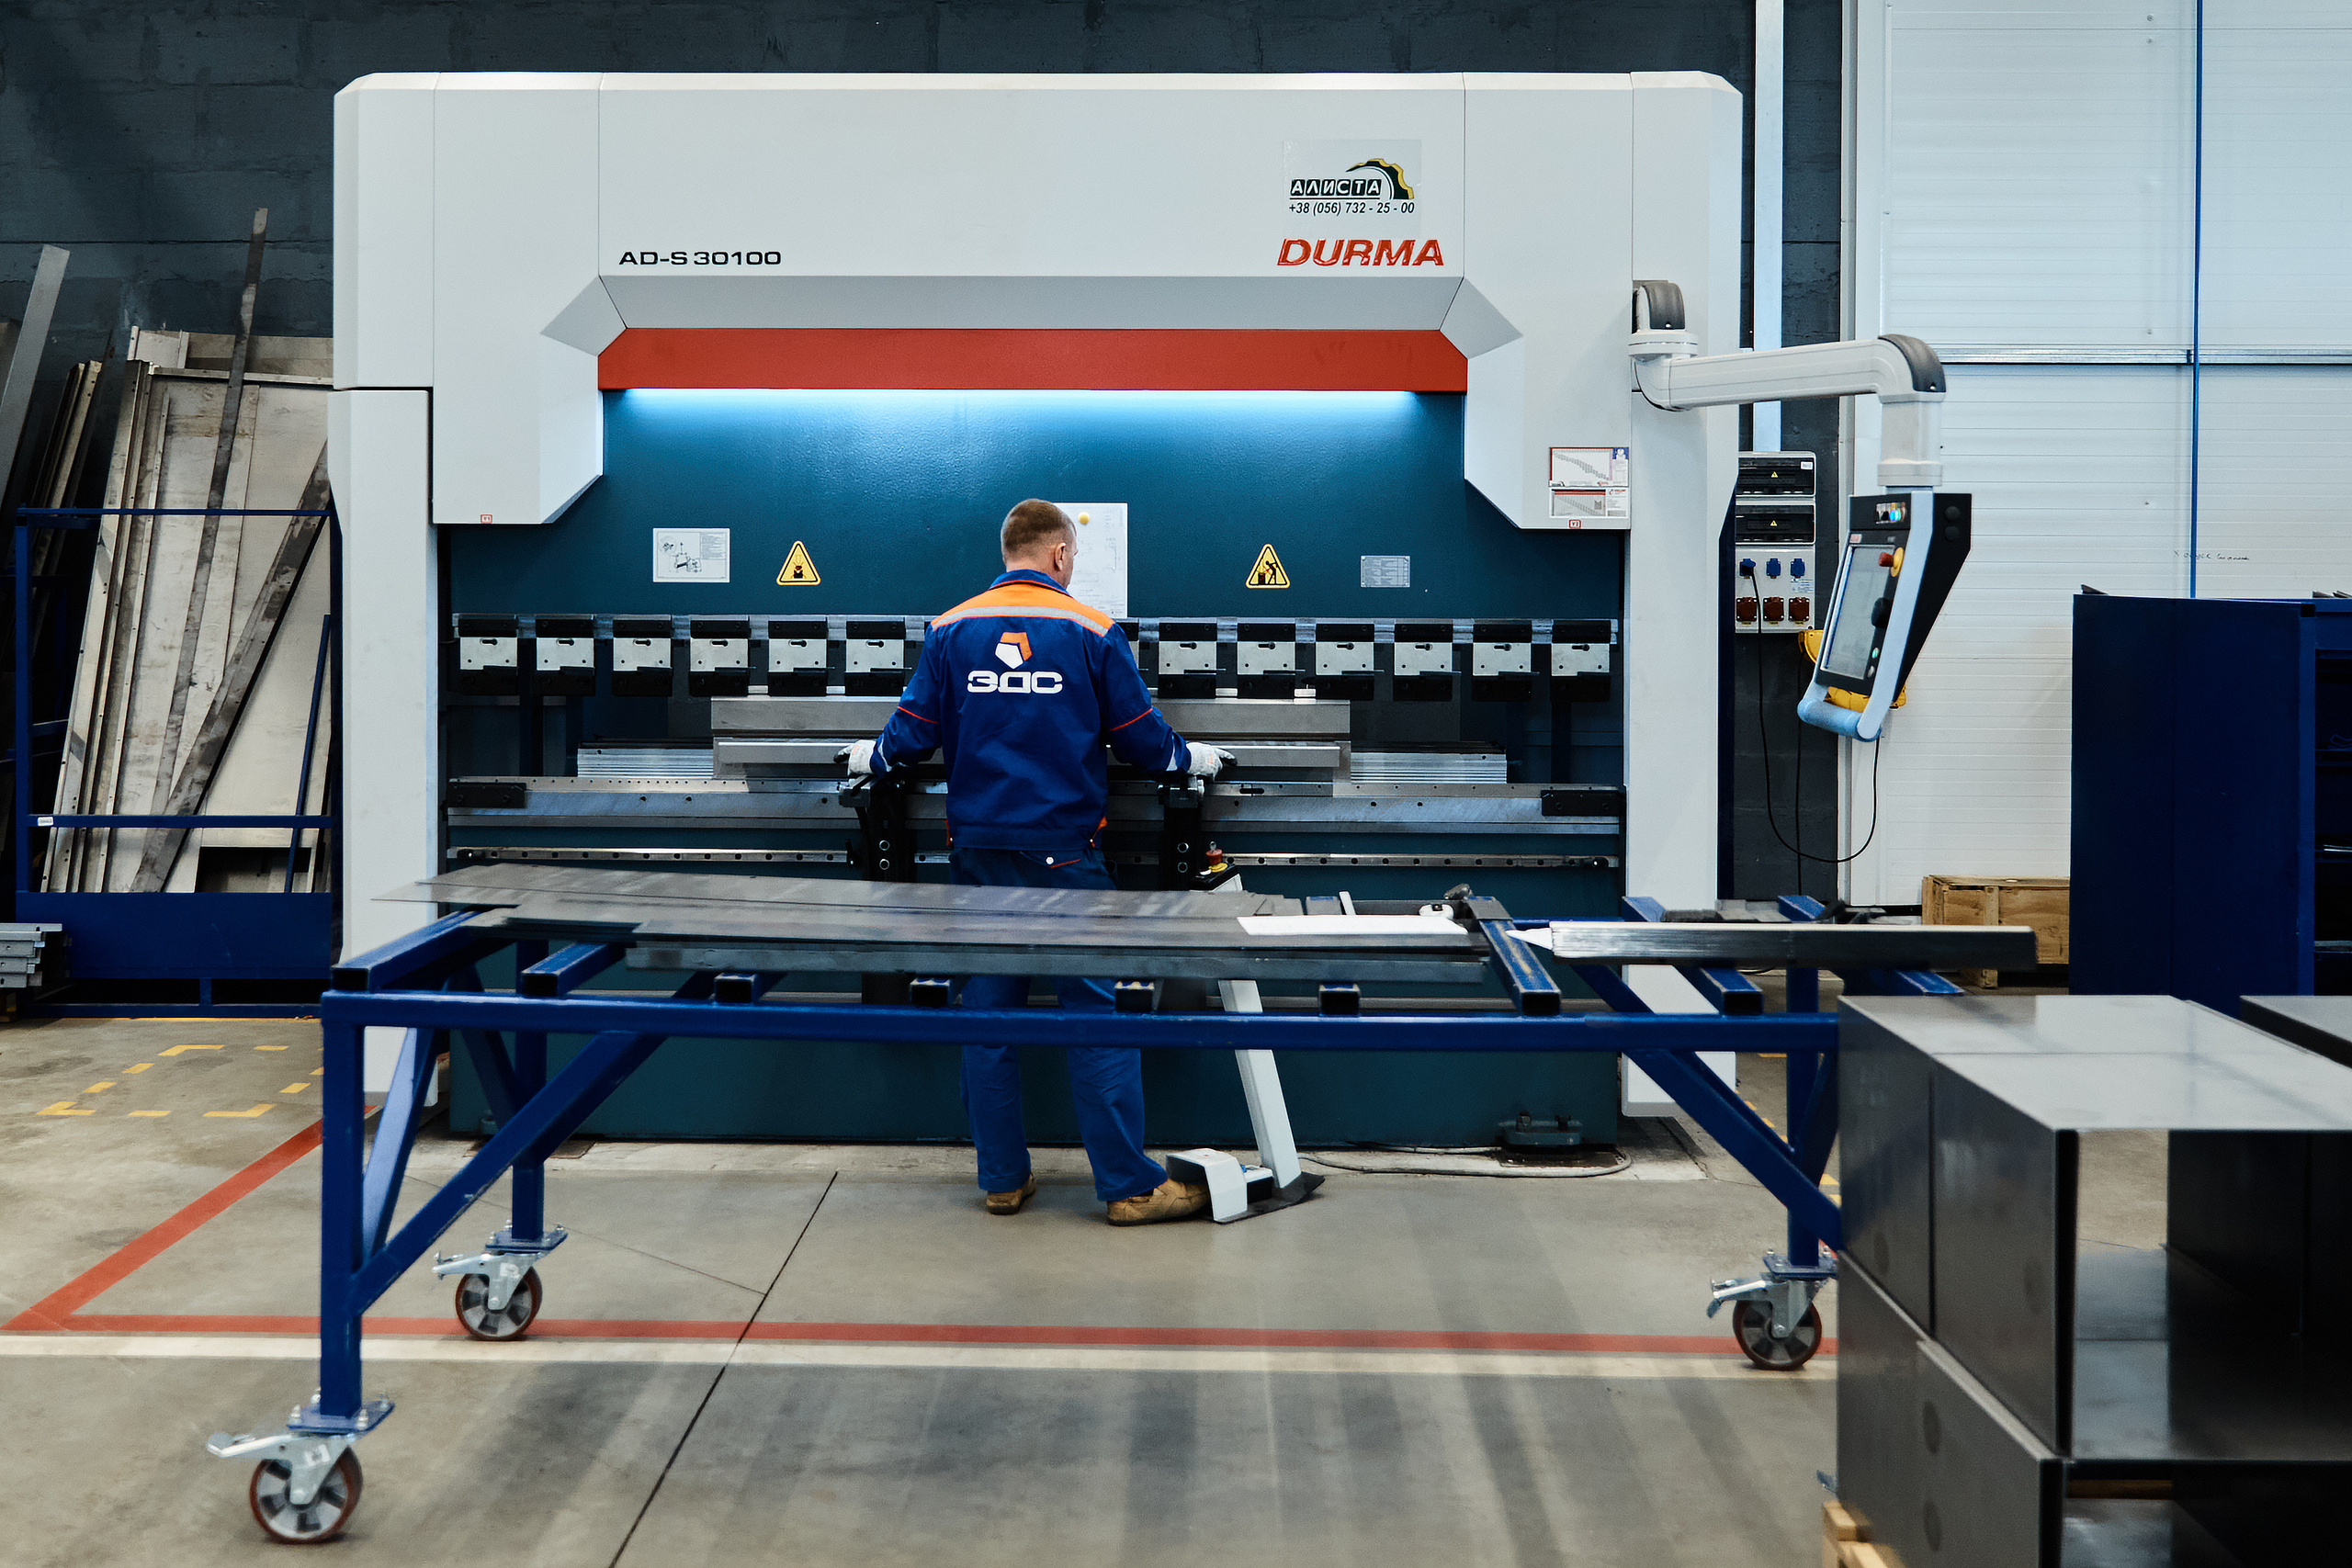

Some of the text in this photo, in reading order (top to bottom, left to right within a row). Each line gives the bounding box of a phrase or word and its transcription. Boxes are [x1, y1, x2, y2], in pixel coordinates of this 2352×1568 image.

[1290, 179, 1381, 196] АЛИСТА
[1289, 202, 1310, 214] +38
[1313, 201, 1341, 217] (056)
[1345, 202, 1366, 213] 732
[1376, 202, 1391, 213] 25
[1400, 202, 1415, 213] 00
[618, 251, 781, 265] AD-S 30100
[1277, 238, 1444, 266] DURMA
